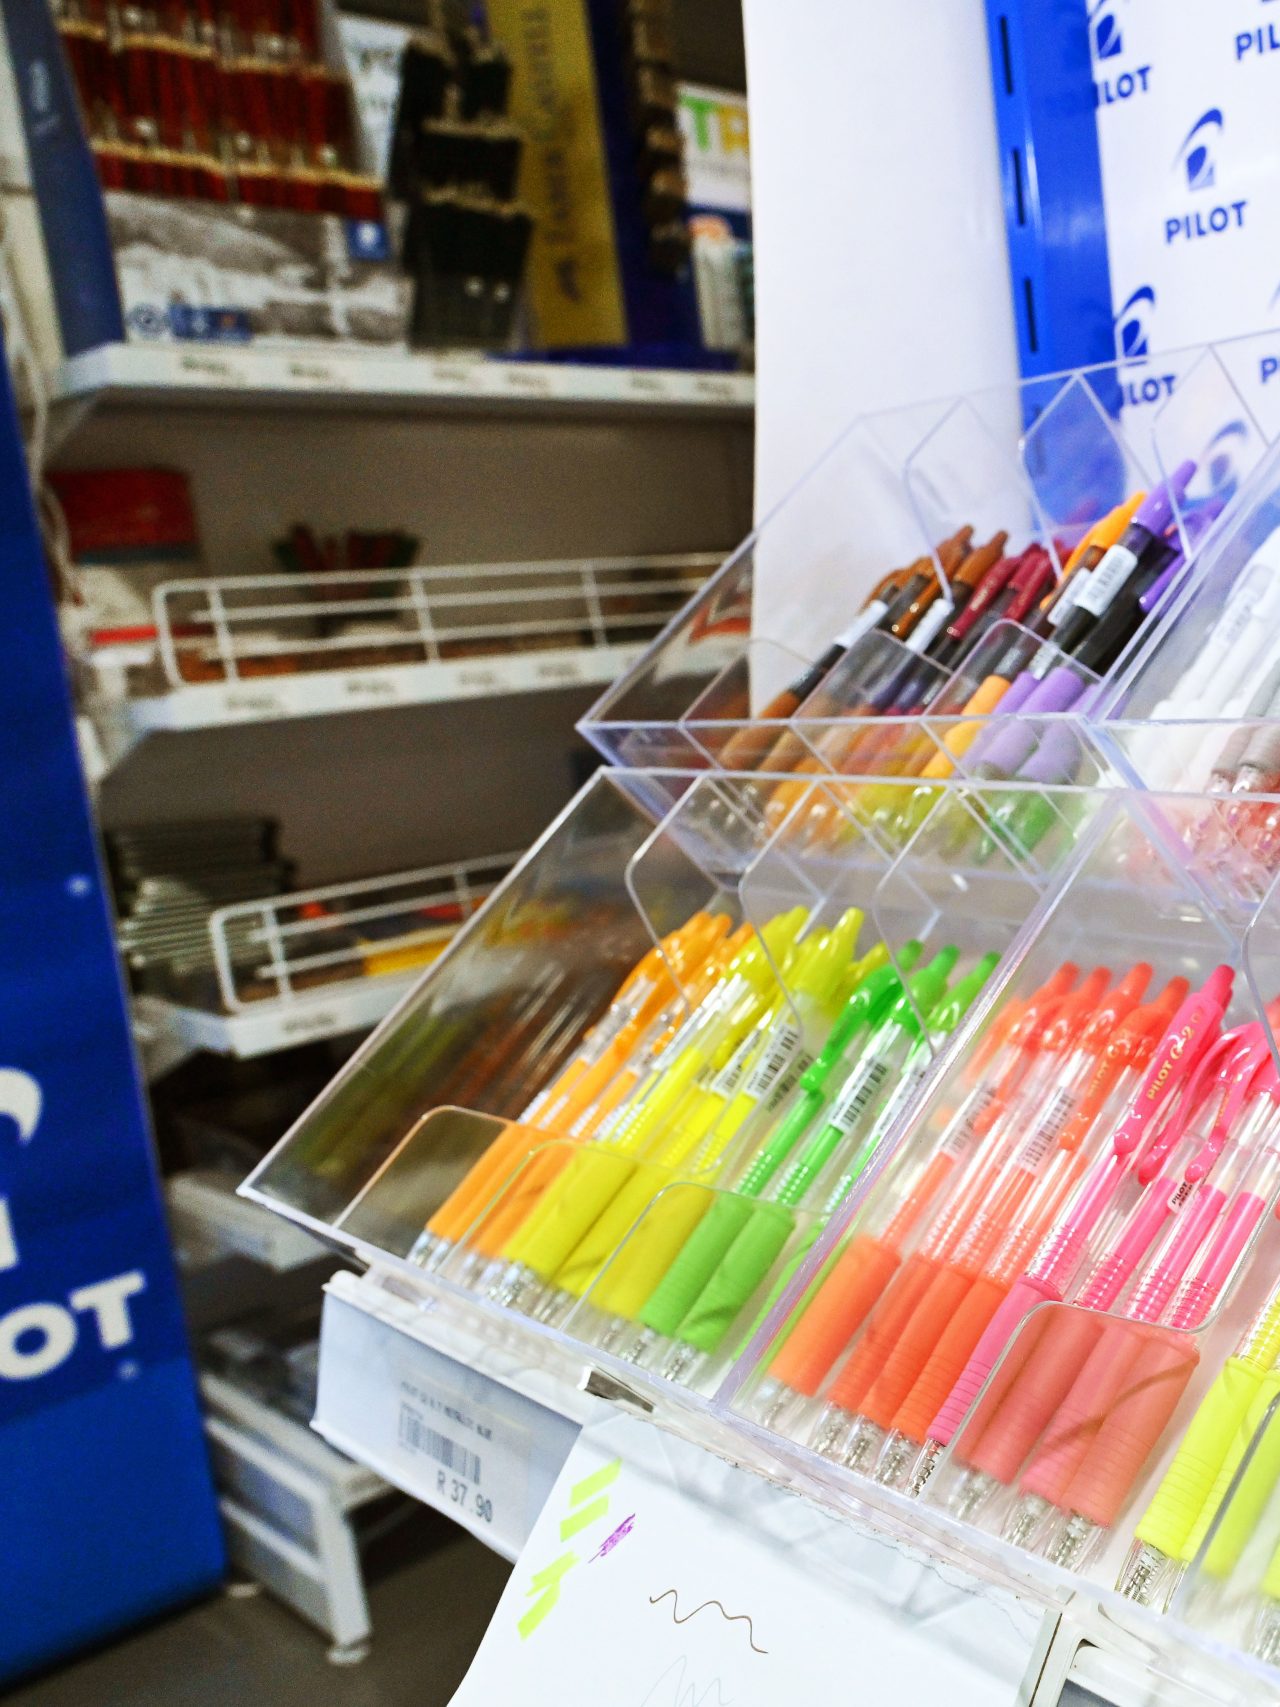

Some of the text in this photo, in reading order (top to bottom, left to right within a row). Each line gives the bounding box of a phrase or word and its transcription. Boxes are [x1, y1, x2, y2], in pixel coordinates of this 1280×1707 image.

[1104, 65, 1151, 104] LOT
[1165, 201, 1247, 244] PILOT
[1128, 375, 1176, 405] LOT
[1147, 1062, 1173, 1100] PILOT
[1172, 1181, 1189, 1206] PILOT
[436, 1469, 446, 1496] R
